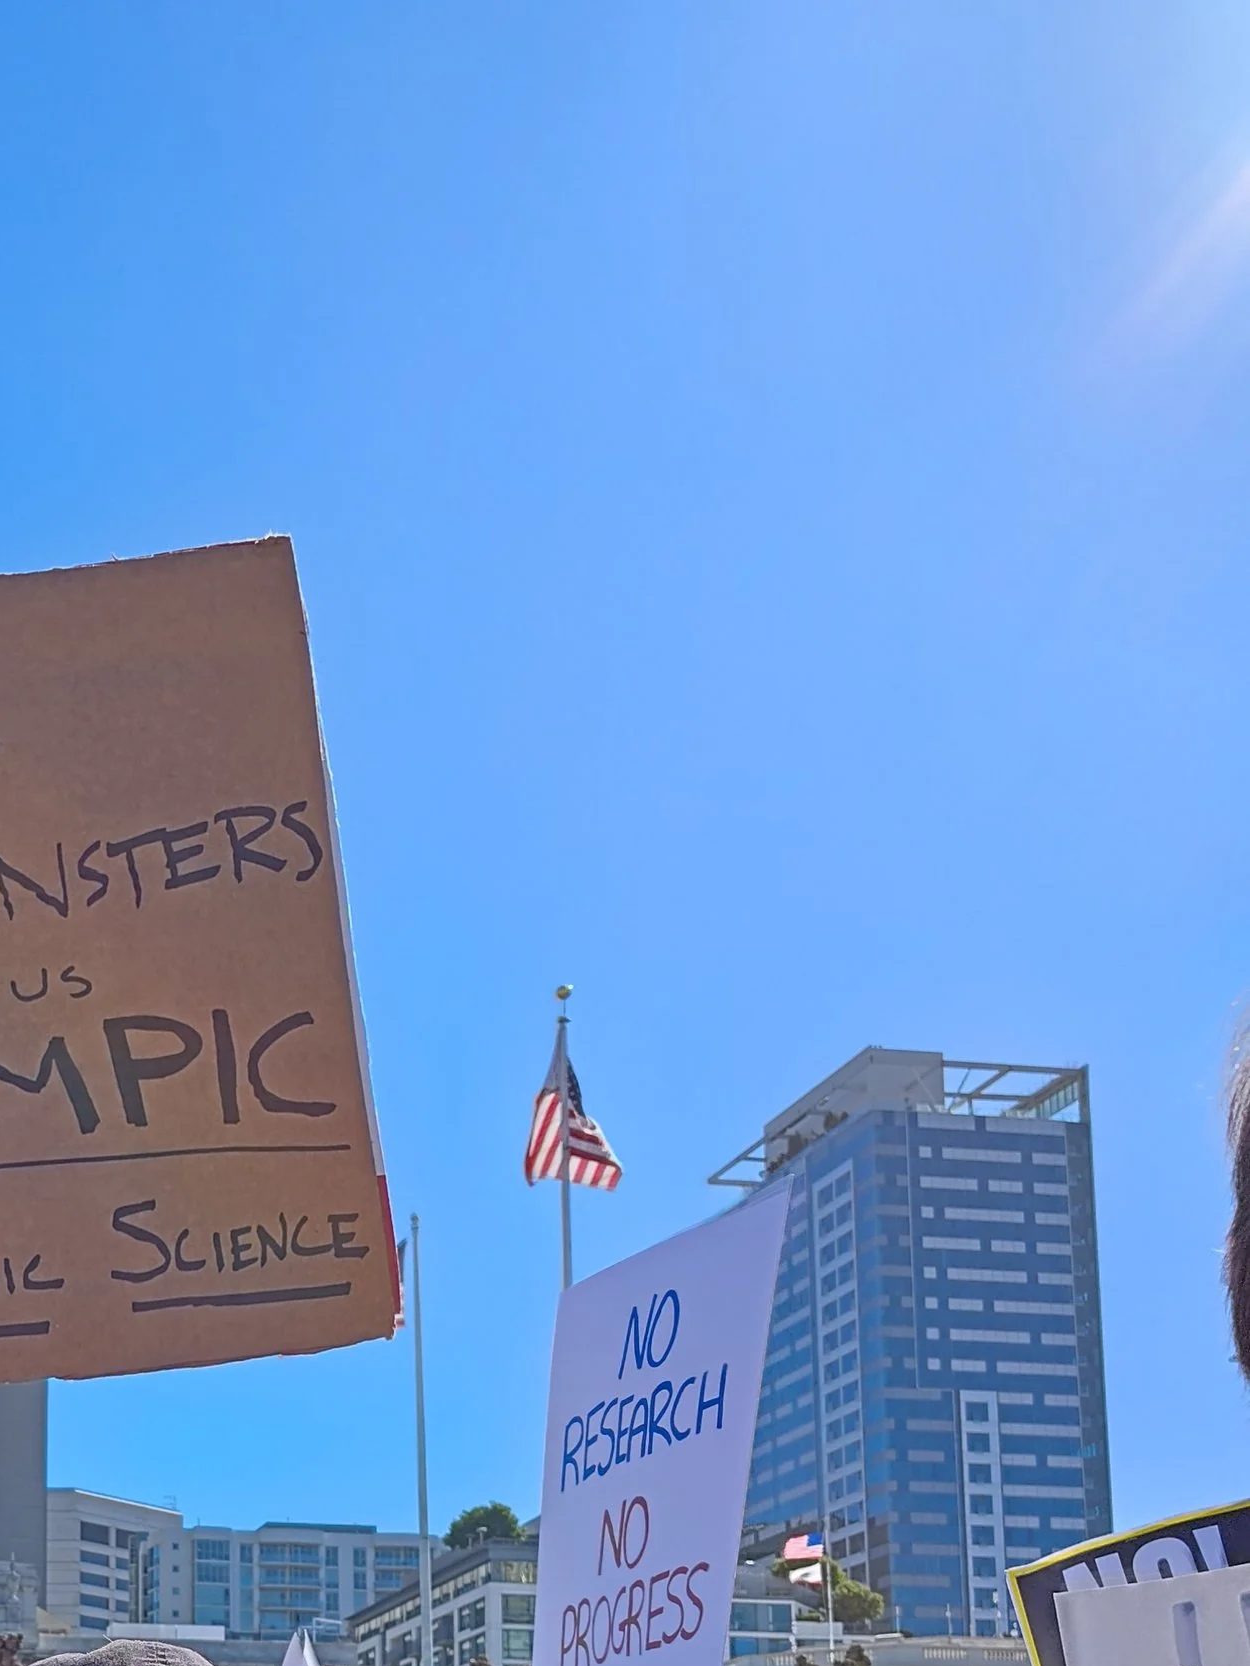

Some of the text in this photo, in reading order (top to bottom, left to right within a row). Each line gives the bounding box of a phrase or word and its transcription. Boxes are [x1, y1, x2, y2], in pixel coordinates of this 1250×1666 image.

[10, 966, 93, 1003] us
[111, 1200, 370, 1283] SCIENCE
[618, 1288, 681, 1380] NO
[560, 1362, 728, 1493] RESEARCH
[598, 1496, 649, 1577] NO
